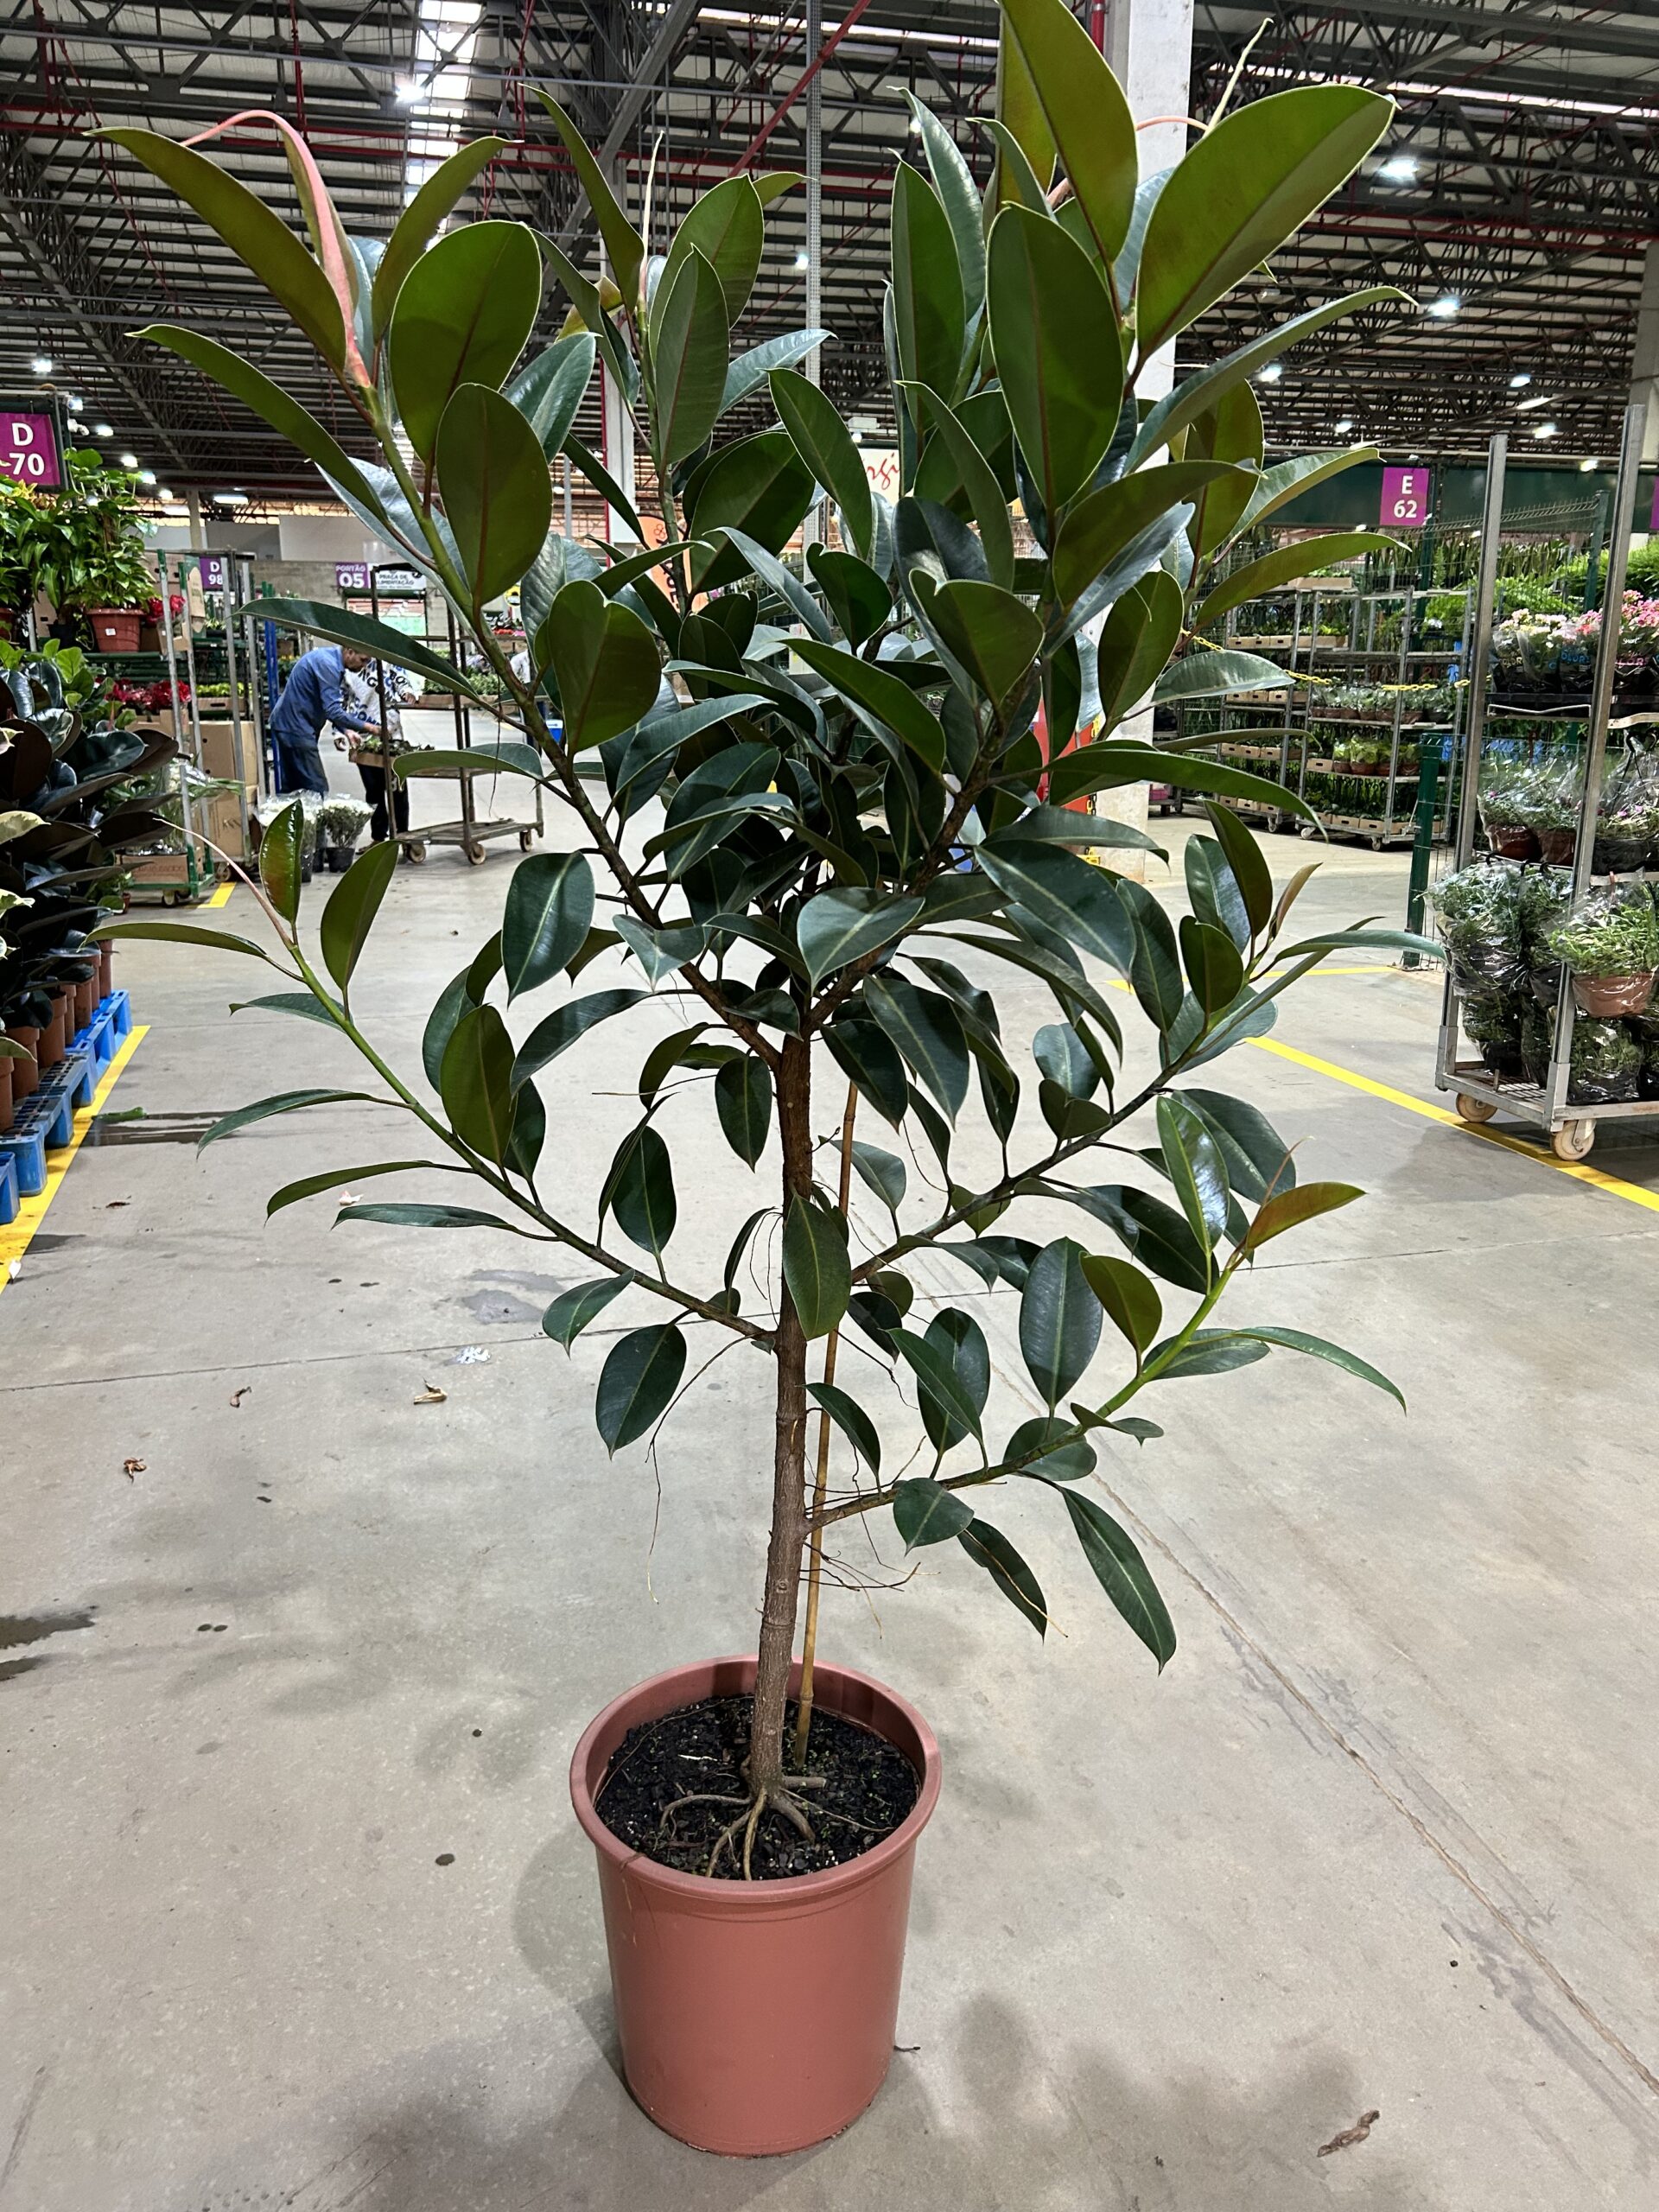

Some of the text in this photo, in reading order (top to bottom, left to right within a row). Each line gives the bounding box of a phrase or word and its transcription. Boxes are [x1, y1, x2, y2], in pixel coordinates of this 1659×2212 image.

[12, 423, 34, 446] D
[10, 453, 45, 476] 70
[1402, 475, 1414, 494] E
[1394, 499, 1418, 518] 62
[209, 561, 220, 572] D
[208, 573, 224, 585] 98
[339, 572, 365, 588] 05
